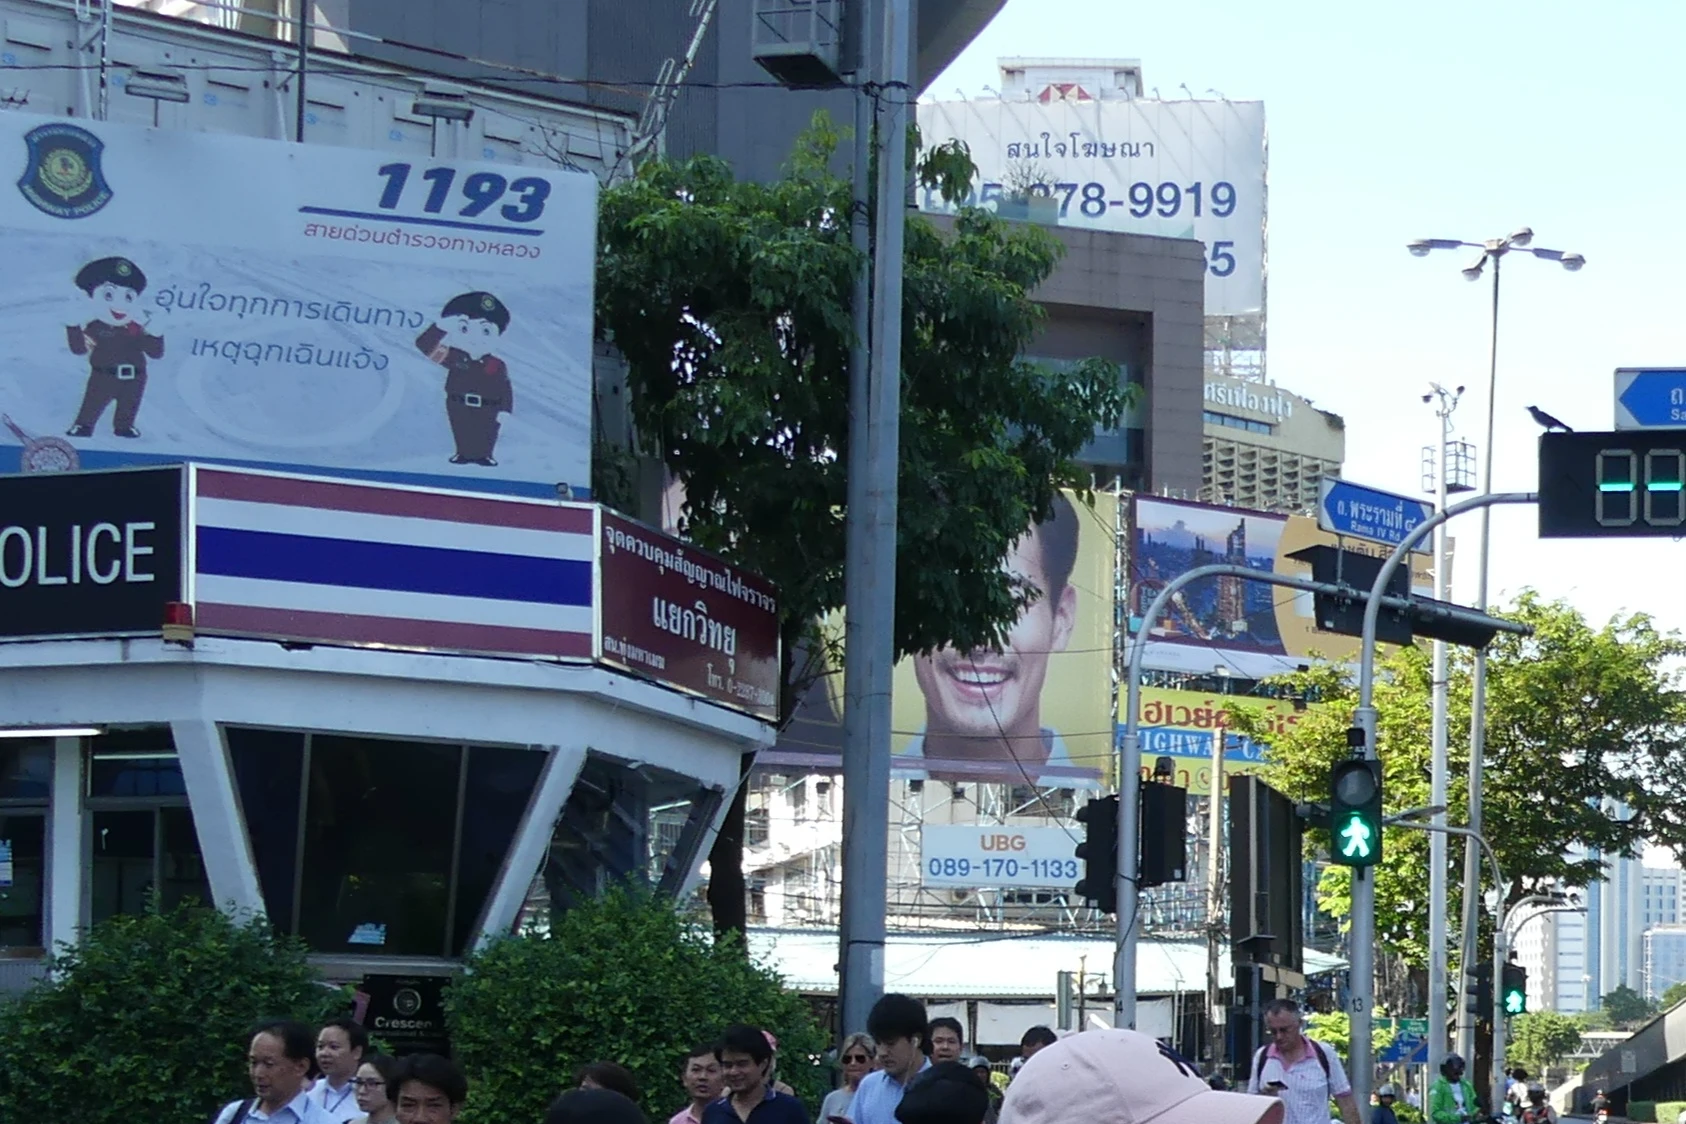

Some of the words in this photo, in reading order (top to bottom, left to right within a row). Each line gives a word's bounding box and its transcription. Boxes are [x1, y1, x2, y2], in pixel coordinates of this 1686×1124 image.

[1006, 132, 1155, 159] สนใจโฆษณา
[378, 162, 552, 223] 1193
[303, 221, 542, 260] สายด่วนตำรวจทางหลวง
[154, 281, 425, 330] อุ่นใจทุกการเดินทาง
[191, 337, 390, 373] เหตุฉุกเฉินแจ้ง
[1351, 520, 1374, 536] Rama
[1376, 527, 1387, 539] IV
[604, 525, 777, 614] จุดควบคุมสัญญาณไฟจราจร
[653, 596, 737, 675] แยกวิทยุ
[980, 834, 1026, 852] UBG
[929, 857, 1078, 879] 089-170-1133
